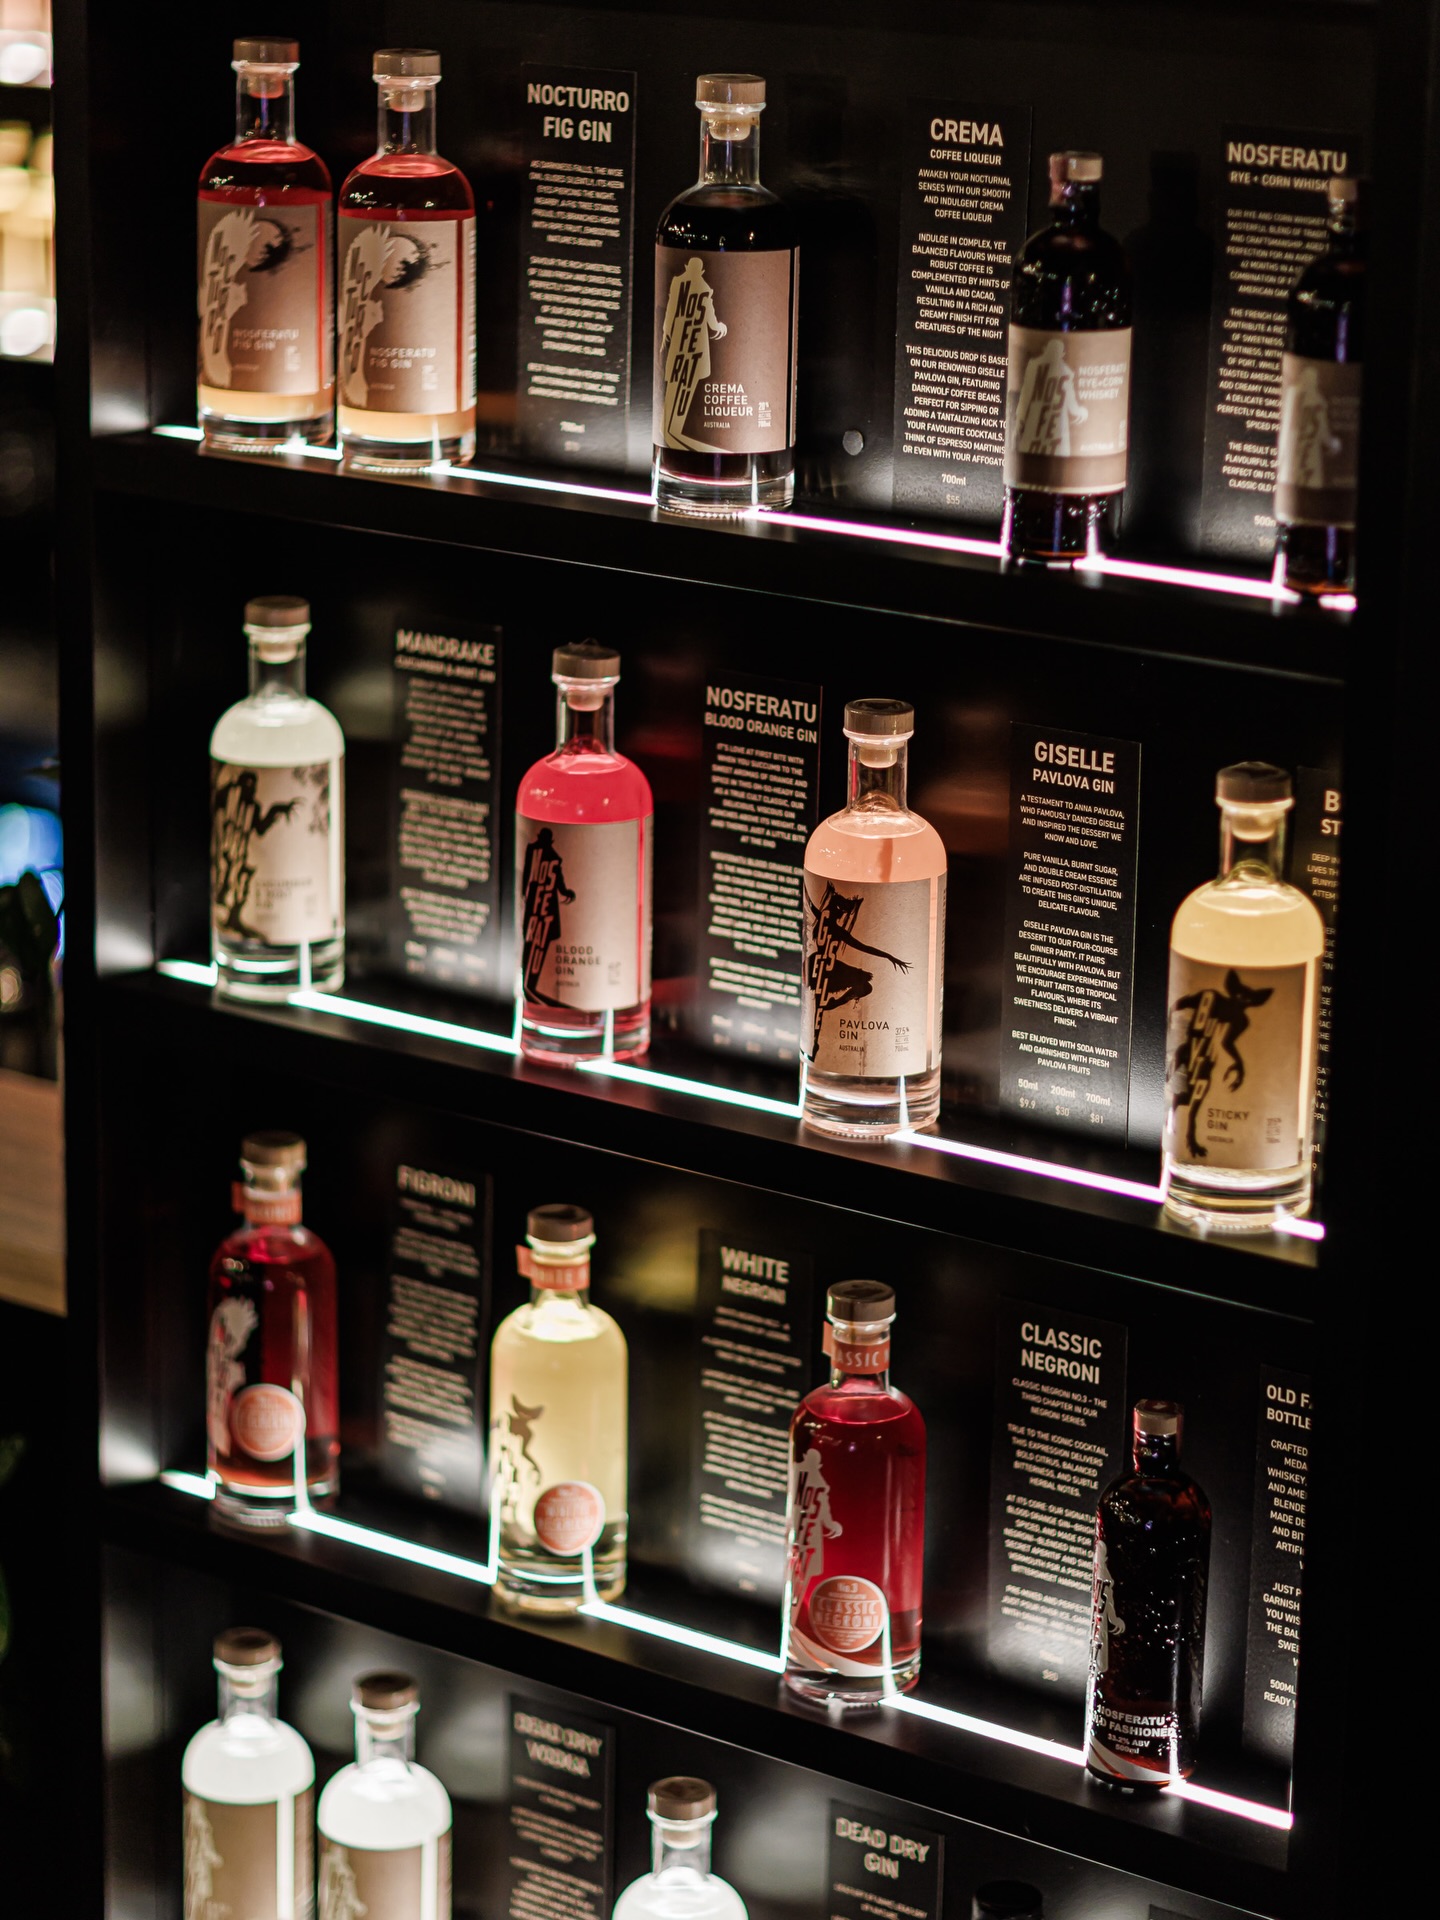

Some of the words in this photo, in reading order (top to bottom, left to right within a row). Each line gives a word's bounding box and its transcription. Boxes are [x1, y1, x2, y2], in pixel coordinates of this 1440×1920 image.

[528, 83, 629, 112] NOCTURRO
[543, 116, 574, 139] FIG
[579, 120, 611, 143] GIN
[930, 118, 1003, 146] CREMA
[930, 149, 962, 161] COFFEE
[964, 152, 1001, 165] LIQUEUR
[1227, 142, 1347, 172] NOSFERATU
[919, 169, 948, 179] AWAKEN
[950, 172, 968, 181] YOUR
[970, 174, 1011, 186] NOCTURNAL
[1230, 171, 1251, 185] RYE
[1262, 174, 1290, 188] CORN
[1294, 176, 1329, 191] WHISK
[919, 182, 945, 192] SENSES
[947, 185, 964, 194] WITH
[966, 187, 980, 196] OUR
[982, 188, 1011, 199] SMOOTH
[924, 195, 938, 204] AND
[940, 197, 978, 208] INDULGENT
[980, 201, 1003, 211] CREMA
[935, 209, 960, 219] COFFEE
[963, 212, 992, 222] LIQUEUR
[919, 233, 948, 244] INDULGE
[950, 236, 957, 245] IN
[959, 237, 992, 249] COMPLEX,
[994, 241, 1006, 250] YET
[912, 245, 948, 257] BALANCED
[950, 249, 985, 261] FLAVOURS
[987, 253, 1011, 264] WHERE
[930, 260, 957, 270] ROBUST
[959, 263, 984, 273] COFFEE
[987, 266, 993, 274] IS
[704, 384, 744, 393] CREMA
[704, 395, 747, 405] COFFEE
[704, 407, 753, 416] LIQUEUR
[704, 421, 730, 429] AUSTRALIA
[942, 474, 966, 486] 700ml
[396, 629, 495, 665] MANDRAKE
[706, 686, 817, 723] NOSFERATU
[705, 712, 744, 731] BLOOD
[747, 719, 794, 739] ORANGE
[797, 728, 817, 744] GIN
[755, 749, 772, 759] FIRST
[774, 752, 786, 762] BITE
[788, 754, 804, 765] WITH
[1035, 741, 1114, 774] GISELLE
[1033, 768, 1089, 790] PAVLOVA
[1093, 778, 1114, 794] GIN
[1027, 796, 1064, 808] TESTAMENT
[1065, 802, 1073, 810] TO
[1075, 803, 1092, 813] ANNA
[1021, 806, 1035, 815] WHO
[1037, 808, 1070, 821] FAMOUSLY
[1072, 814, 1097, 826] DANCED
[1099, 819, 1124, 830] GISELLE
[1022, 818, 1036, 827] AND
[1037, 820, 1066, 832] INSPIRED
[1068, 825, 1080, 834] THE
[1081, 827, 1110, 839] DESSERT
[1111, 832, 1121, 841] WE
[1045, 833, 1064, 843] KNOW
[1066, 836, 1079, 845] AND
[1081, 839, 1098, 848] LOVE.
[1024, 852, 1040, 862] PURE
[1042, 855, 1070, 867] VANILLA,
[1072, 860, 1093, 871] BURNT
[1095, 864, 1118, 876] SUGAR,
[556, 944, 593, 955] BLOOD
[556, 956, 600, 965] ORANGE
[556, 966, 575, 976] GIN
[840, 1019, 889, 1030] PAVLOVA
[840, 1030, 858, 1040] GIN
[1018, 1078, 1038, 1091] 50ml
[1051, 1085, 1075, 1099] 200ml
[1086, 1091, 1111, 1106] 700ml
[1208, 1108, 1249, 1120] STICKY
[1207, 1120, 1228, 1131] GIN
[720, 1246, 789, 1284] WHITE
[721, 1275, 786, 1305] NEGRONI
[1021, 1322, 1102, 1359] CLASSIC
[1021, 1349, 1100, 1384] NEGRONI
[1042, 1385, 1070, 1399] NEGRONI
[1094, 1397, 1108, 1408] THE
[1267, 1384, 1296, 1406] OLD
[1031, 1406, 1060, 1421] NEGRONI
[1043, 1397, 1072, 1412] CHAPTER
[1083, 1406, 1098, 1418] OUR
[1271, 1439, 1308, 1456] CRAFTED
[1268, 1482, 1286, 1495] AND
[1287, 1486, 1305, 1500] AME
[1274, 1498, 1306, 1513] BLENDE
[1270, 1510, 1293, 1525] MADE
[1272, 1525, 1290, 1538] AND
[1272, 1582, 1294, 1595] JUST
[818, 1599, 877, 1614] CLASSIC
[1266, 1608, 1283, 1621] YOU
[815, 1611, 878, 1628] NEGRONI
[1266, 1622, 1282, 1635] THE
[1264, 1691, 1291, 1707] READY
[1097, 1704, 1165, 1726] NOSFERATU
[1109, 1717, 1176, 1737] FASHIONED
[1132, 1737, 1150, 1747] ABV
[836, 1816, 886, 1850] DEAD
[890, 1832, 930, 1862] DRY
[864, 1852, 899, 1879] GIN
